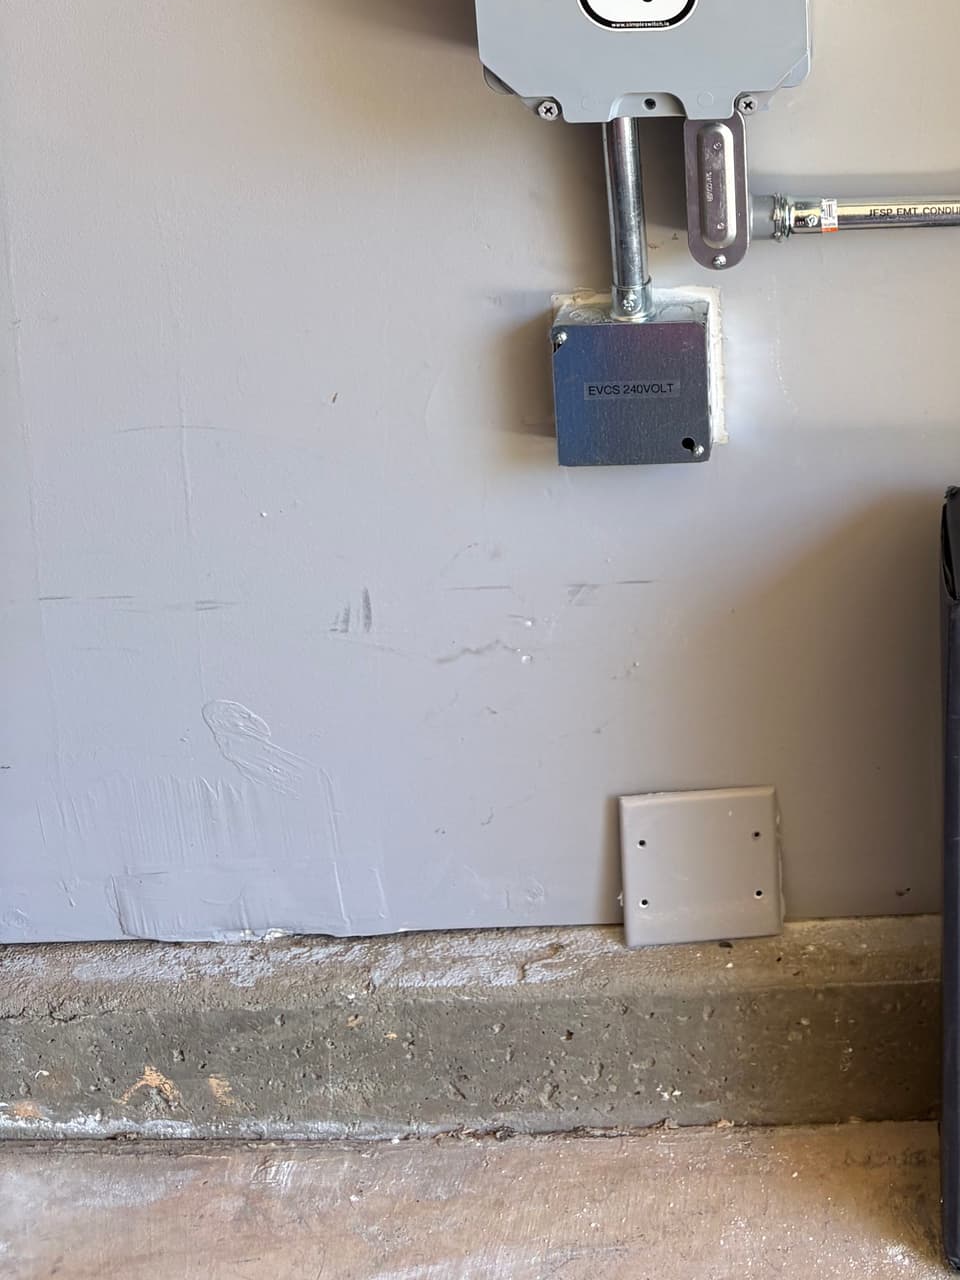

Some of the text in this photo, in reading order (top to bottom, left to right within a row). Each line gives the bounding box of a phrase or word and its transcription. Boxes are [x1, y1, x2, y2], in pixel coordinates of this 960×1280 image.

[896, 207, 919, 216] EMT
[588, 383, 674, 396] EVCS 240VOLT
